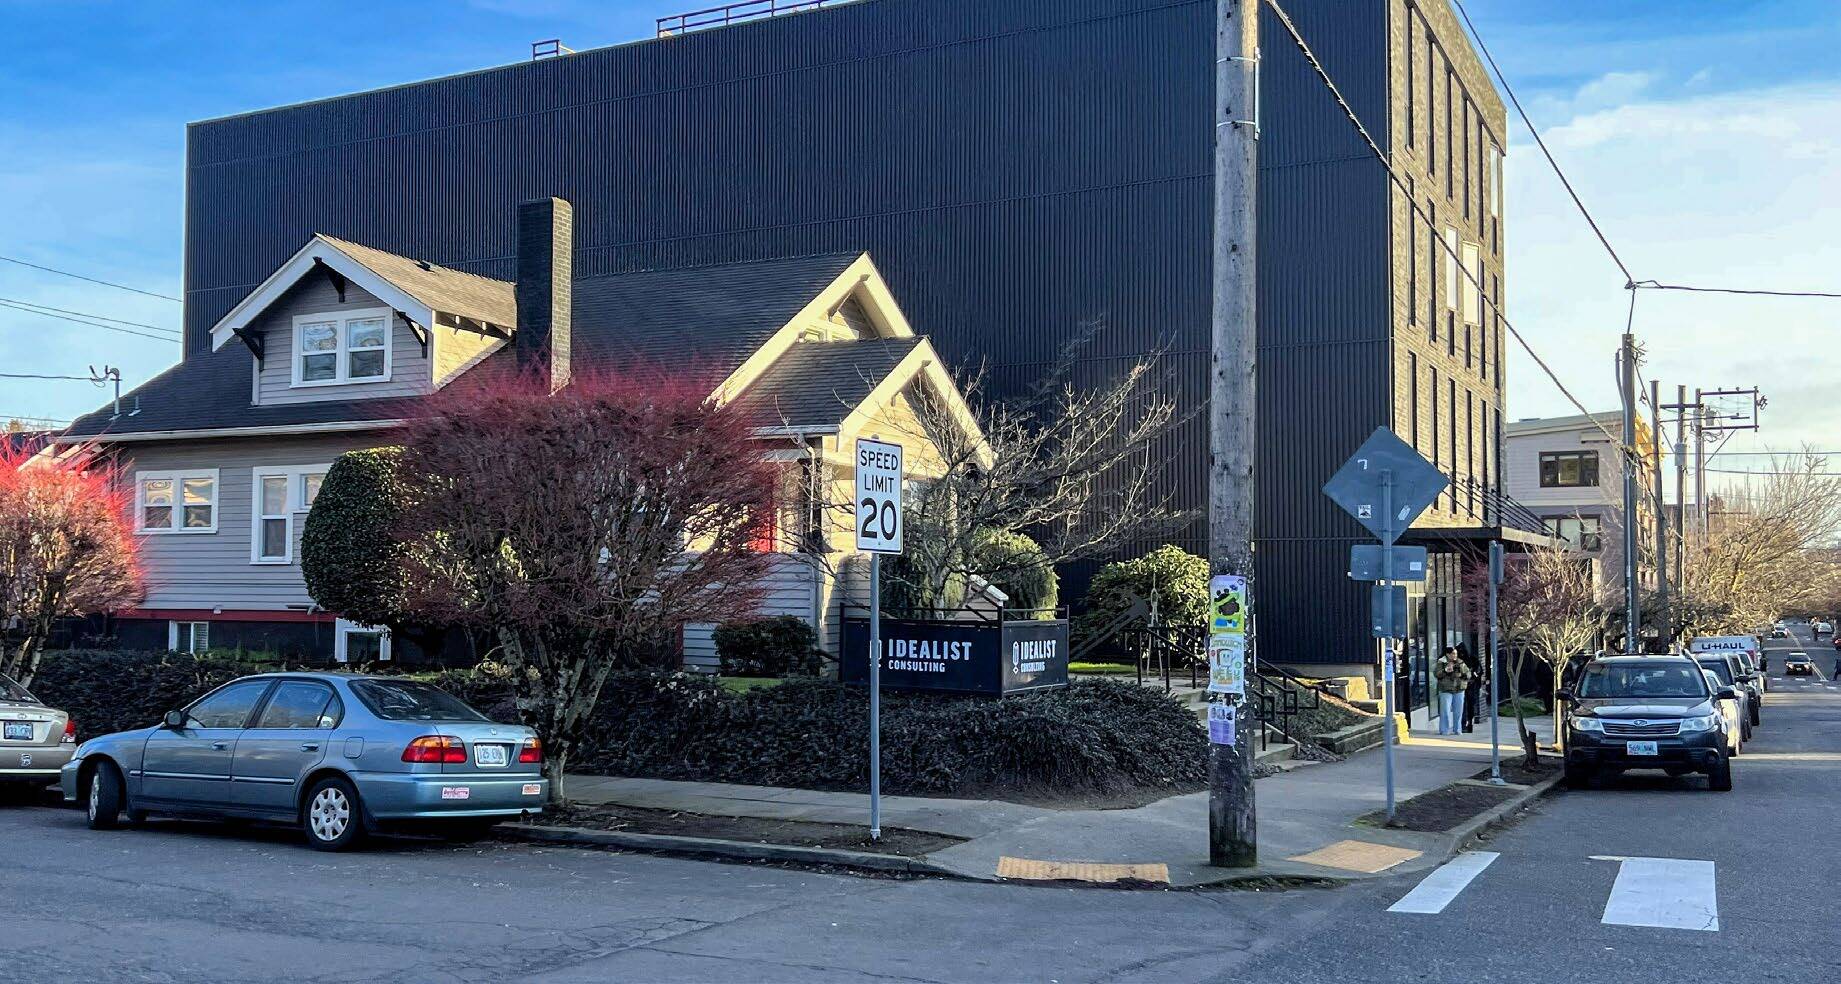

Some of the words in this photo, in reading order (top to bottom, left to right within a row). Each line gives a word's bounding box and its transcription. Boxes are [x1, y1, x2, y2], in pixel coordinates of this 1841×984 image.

[860, 449, 899, 471] SPEED
[864, 474, 895, 493] LIMIT
[860, 497, 897, 541] 20
[888, 639, 972, 660] IDEALIST
[1020, 639, 1057, 660] IDEALIST
[1701, 642, 1745, 650] U-HAUL
[888, 660, 946, 672] CONSULTING
